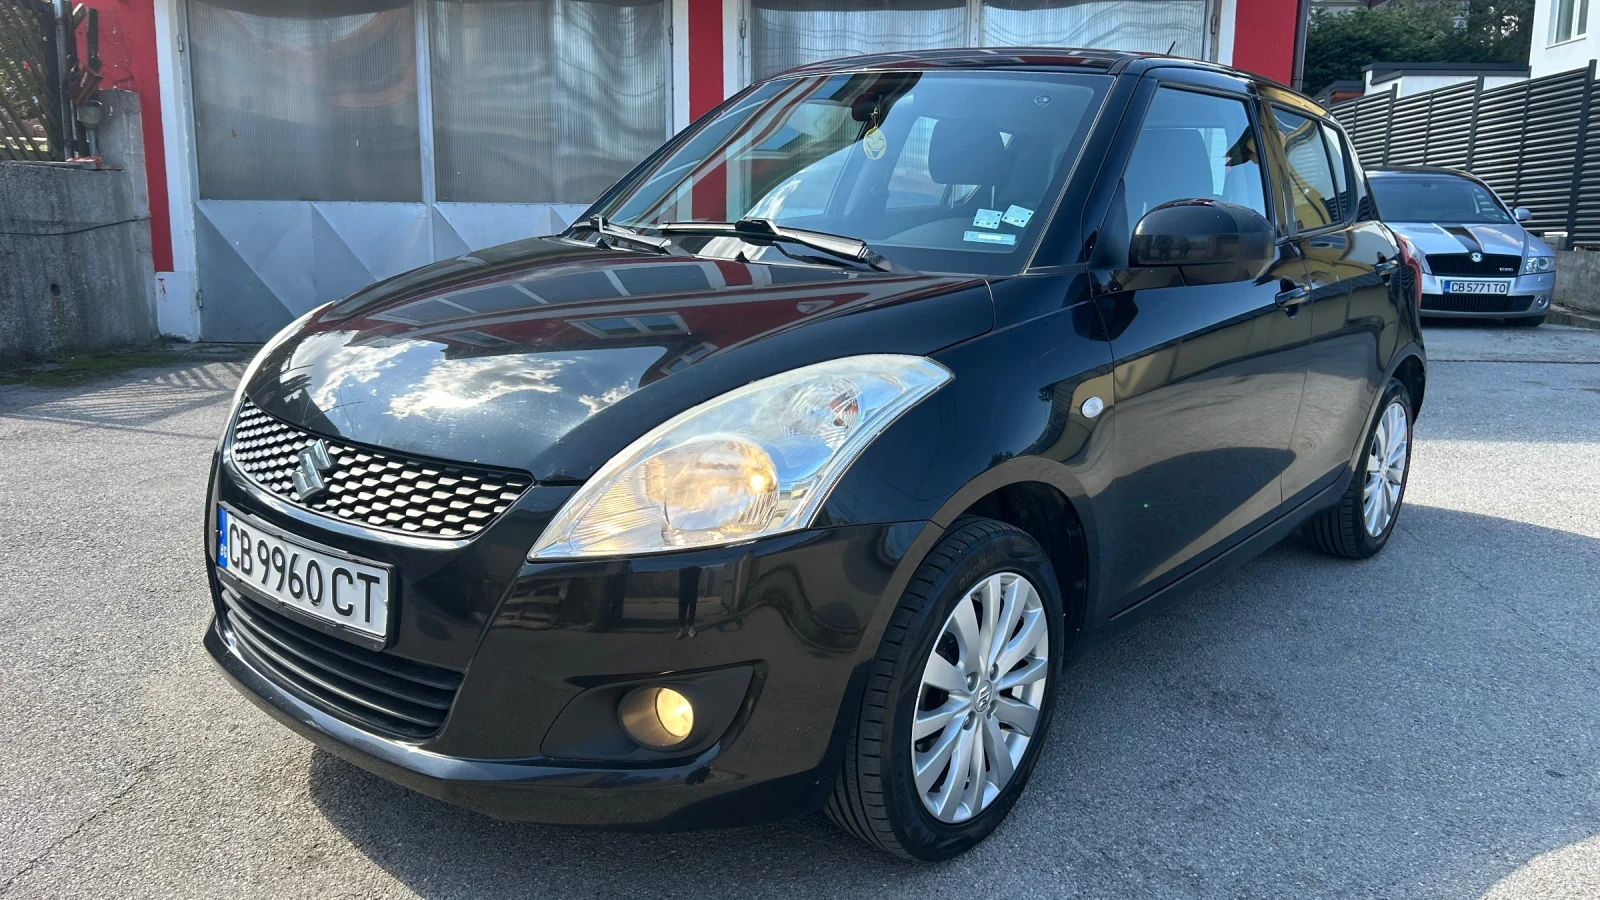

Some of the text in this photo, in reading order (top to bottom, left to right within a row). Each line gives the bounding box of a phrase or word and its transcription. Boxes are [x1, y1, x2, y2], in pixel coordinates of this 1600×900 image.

[1451, 283, 1465, 292] CB
[1466, 283, 1490, 293] 5771
[229, 523, 380, 623] CB 9960 CT
